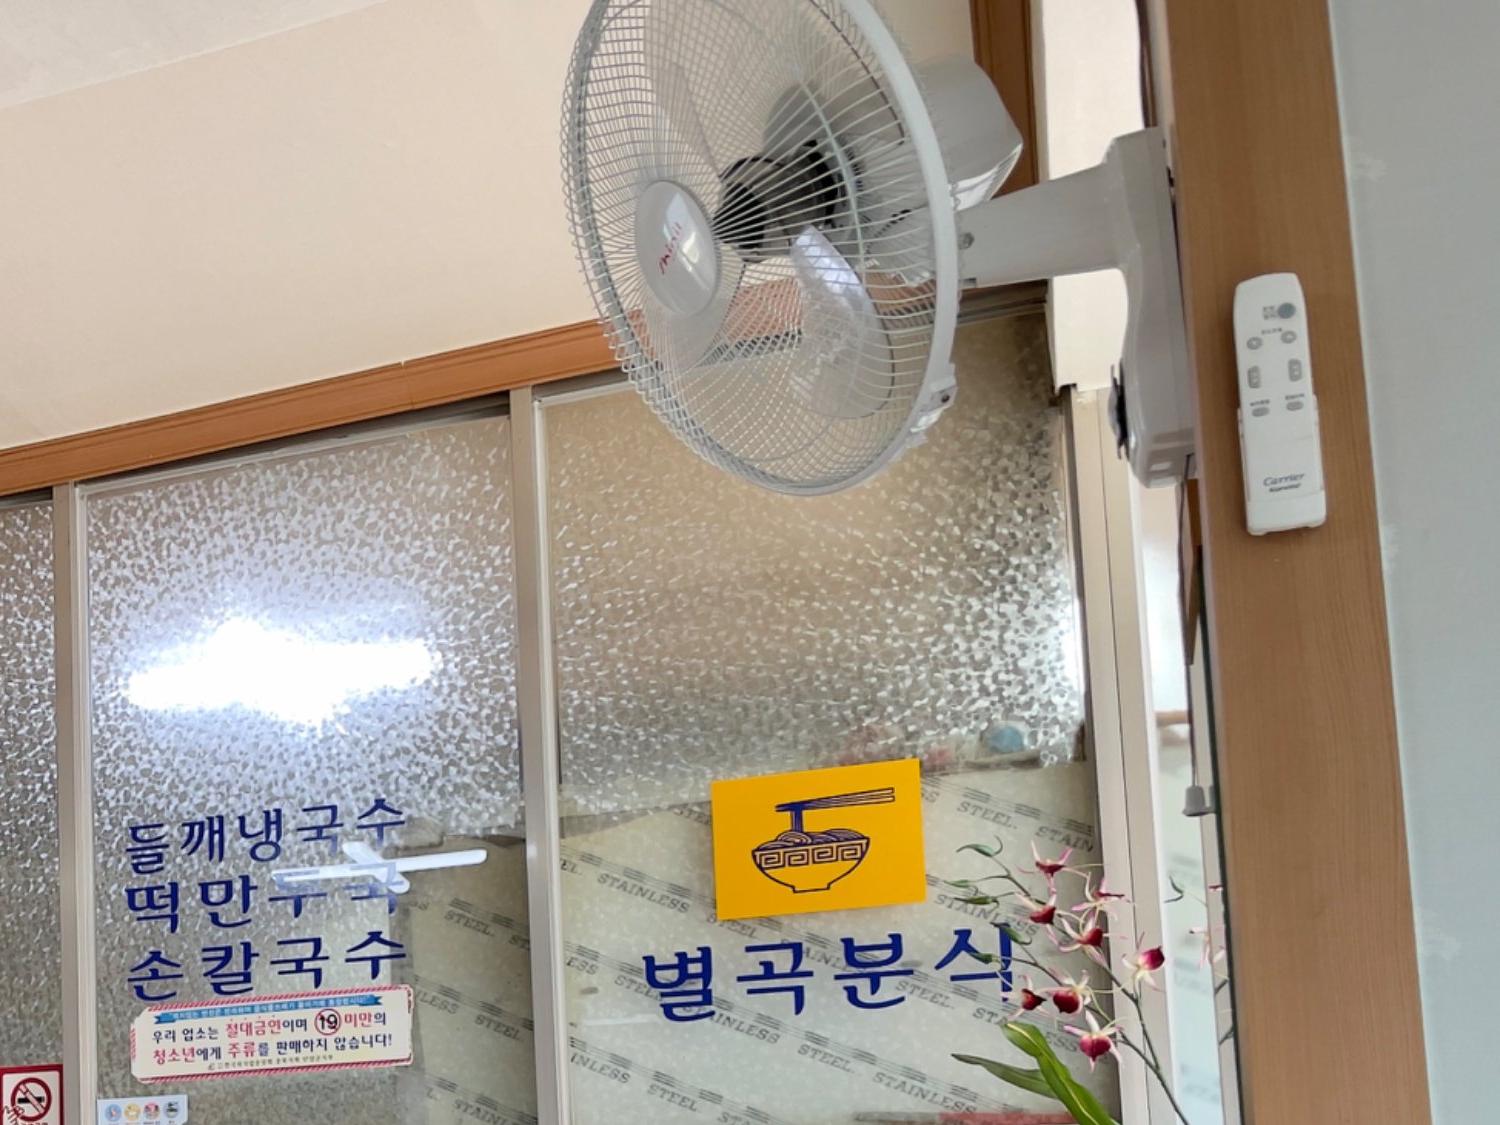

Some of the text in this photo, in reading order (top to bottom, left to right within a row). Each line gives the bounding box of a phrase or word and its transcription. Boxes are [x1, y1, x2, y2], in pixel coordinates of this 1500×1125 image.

[124, 798, 406, 874] 들깨냉국수
[127, 930, 407, 1001] 손칼국수
[641, 922, 1014, 1023] 별곡분식
[152, 1012, 386, 1044] 우리 업소는 절대금연이며 19 미만의
[153, 1033, 392, 1065] 청소년에게 주류를 판매하지 않습니다!
